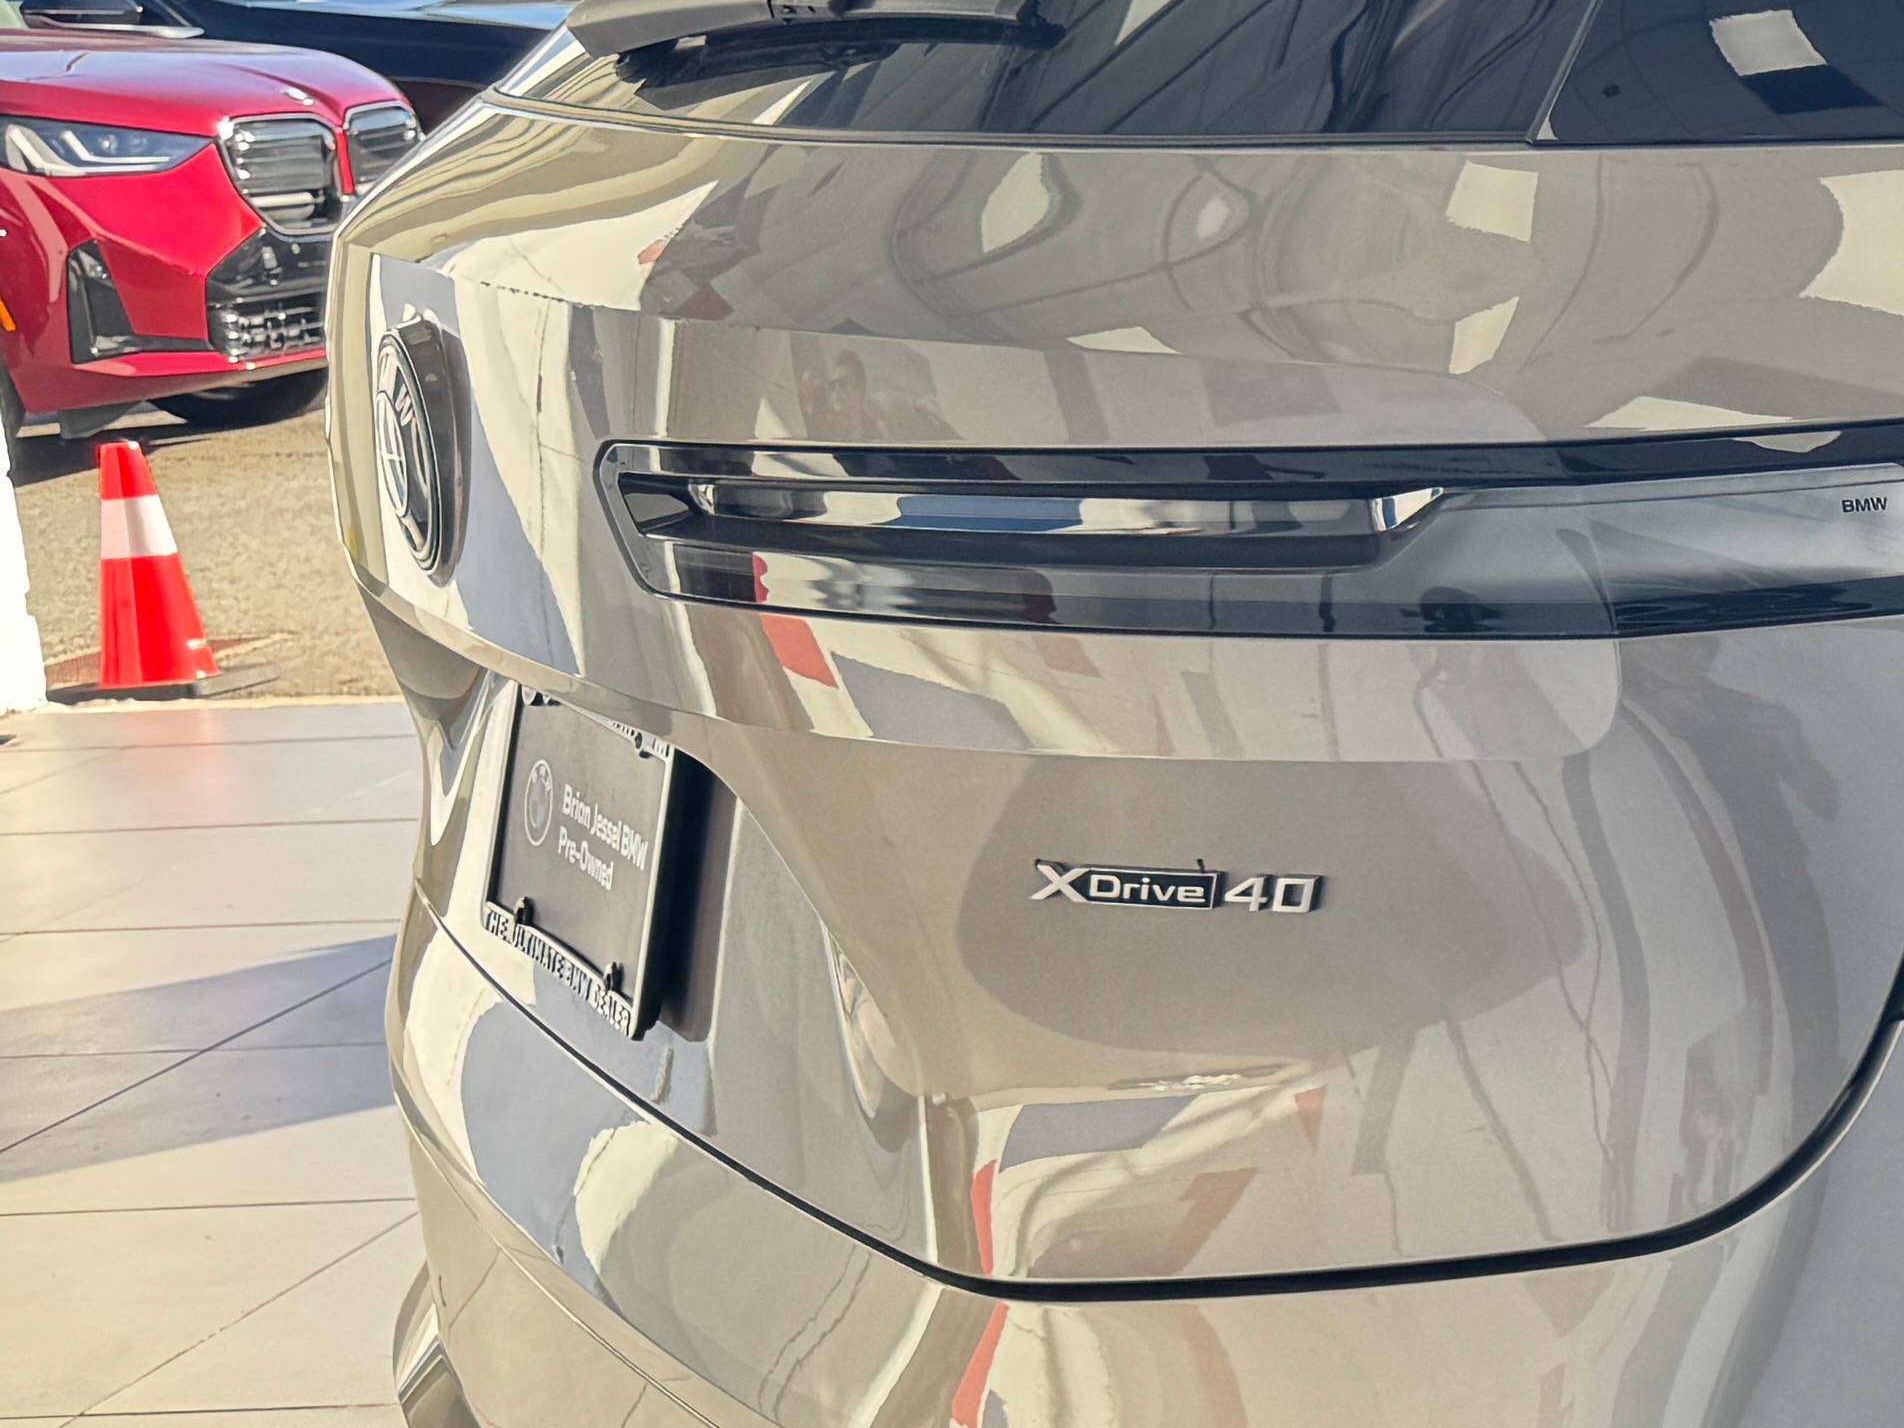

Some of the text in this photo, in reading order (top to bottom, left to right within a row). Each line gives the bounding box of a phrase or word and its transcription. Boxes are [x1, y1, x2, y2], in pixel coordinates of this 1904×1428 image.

[1841, 497, 1888, 513] BMW
[562, 784, 649, 871] Brian Jessel BMW
[558, 825, 614, 890] Pre-Owned
[1224, 874, 1323, 914] 40
